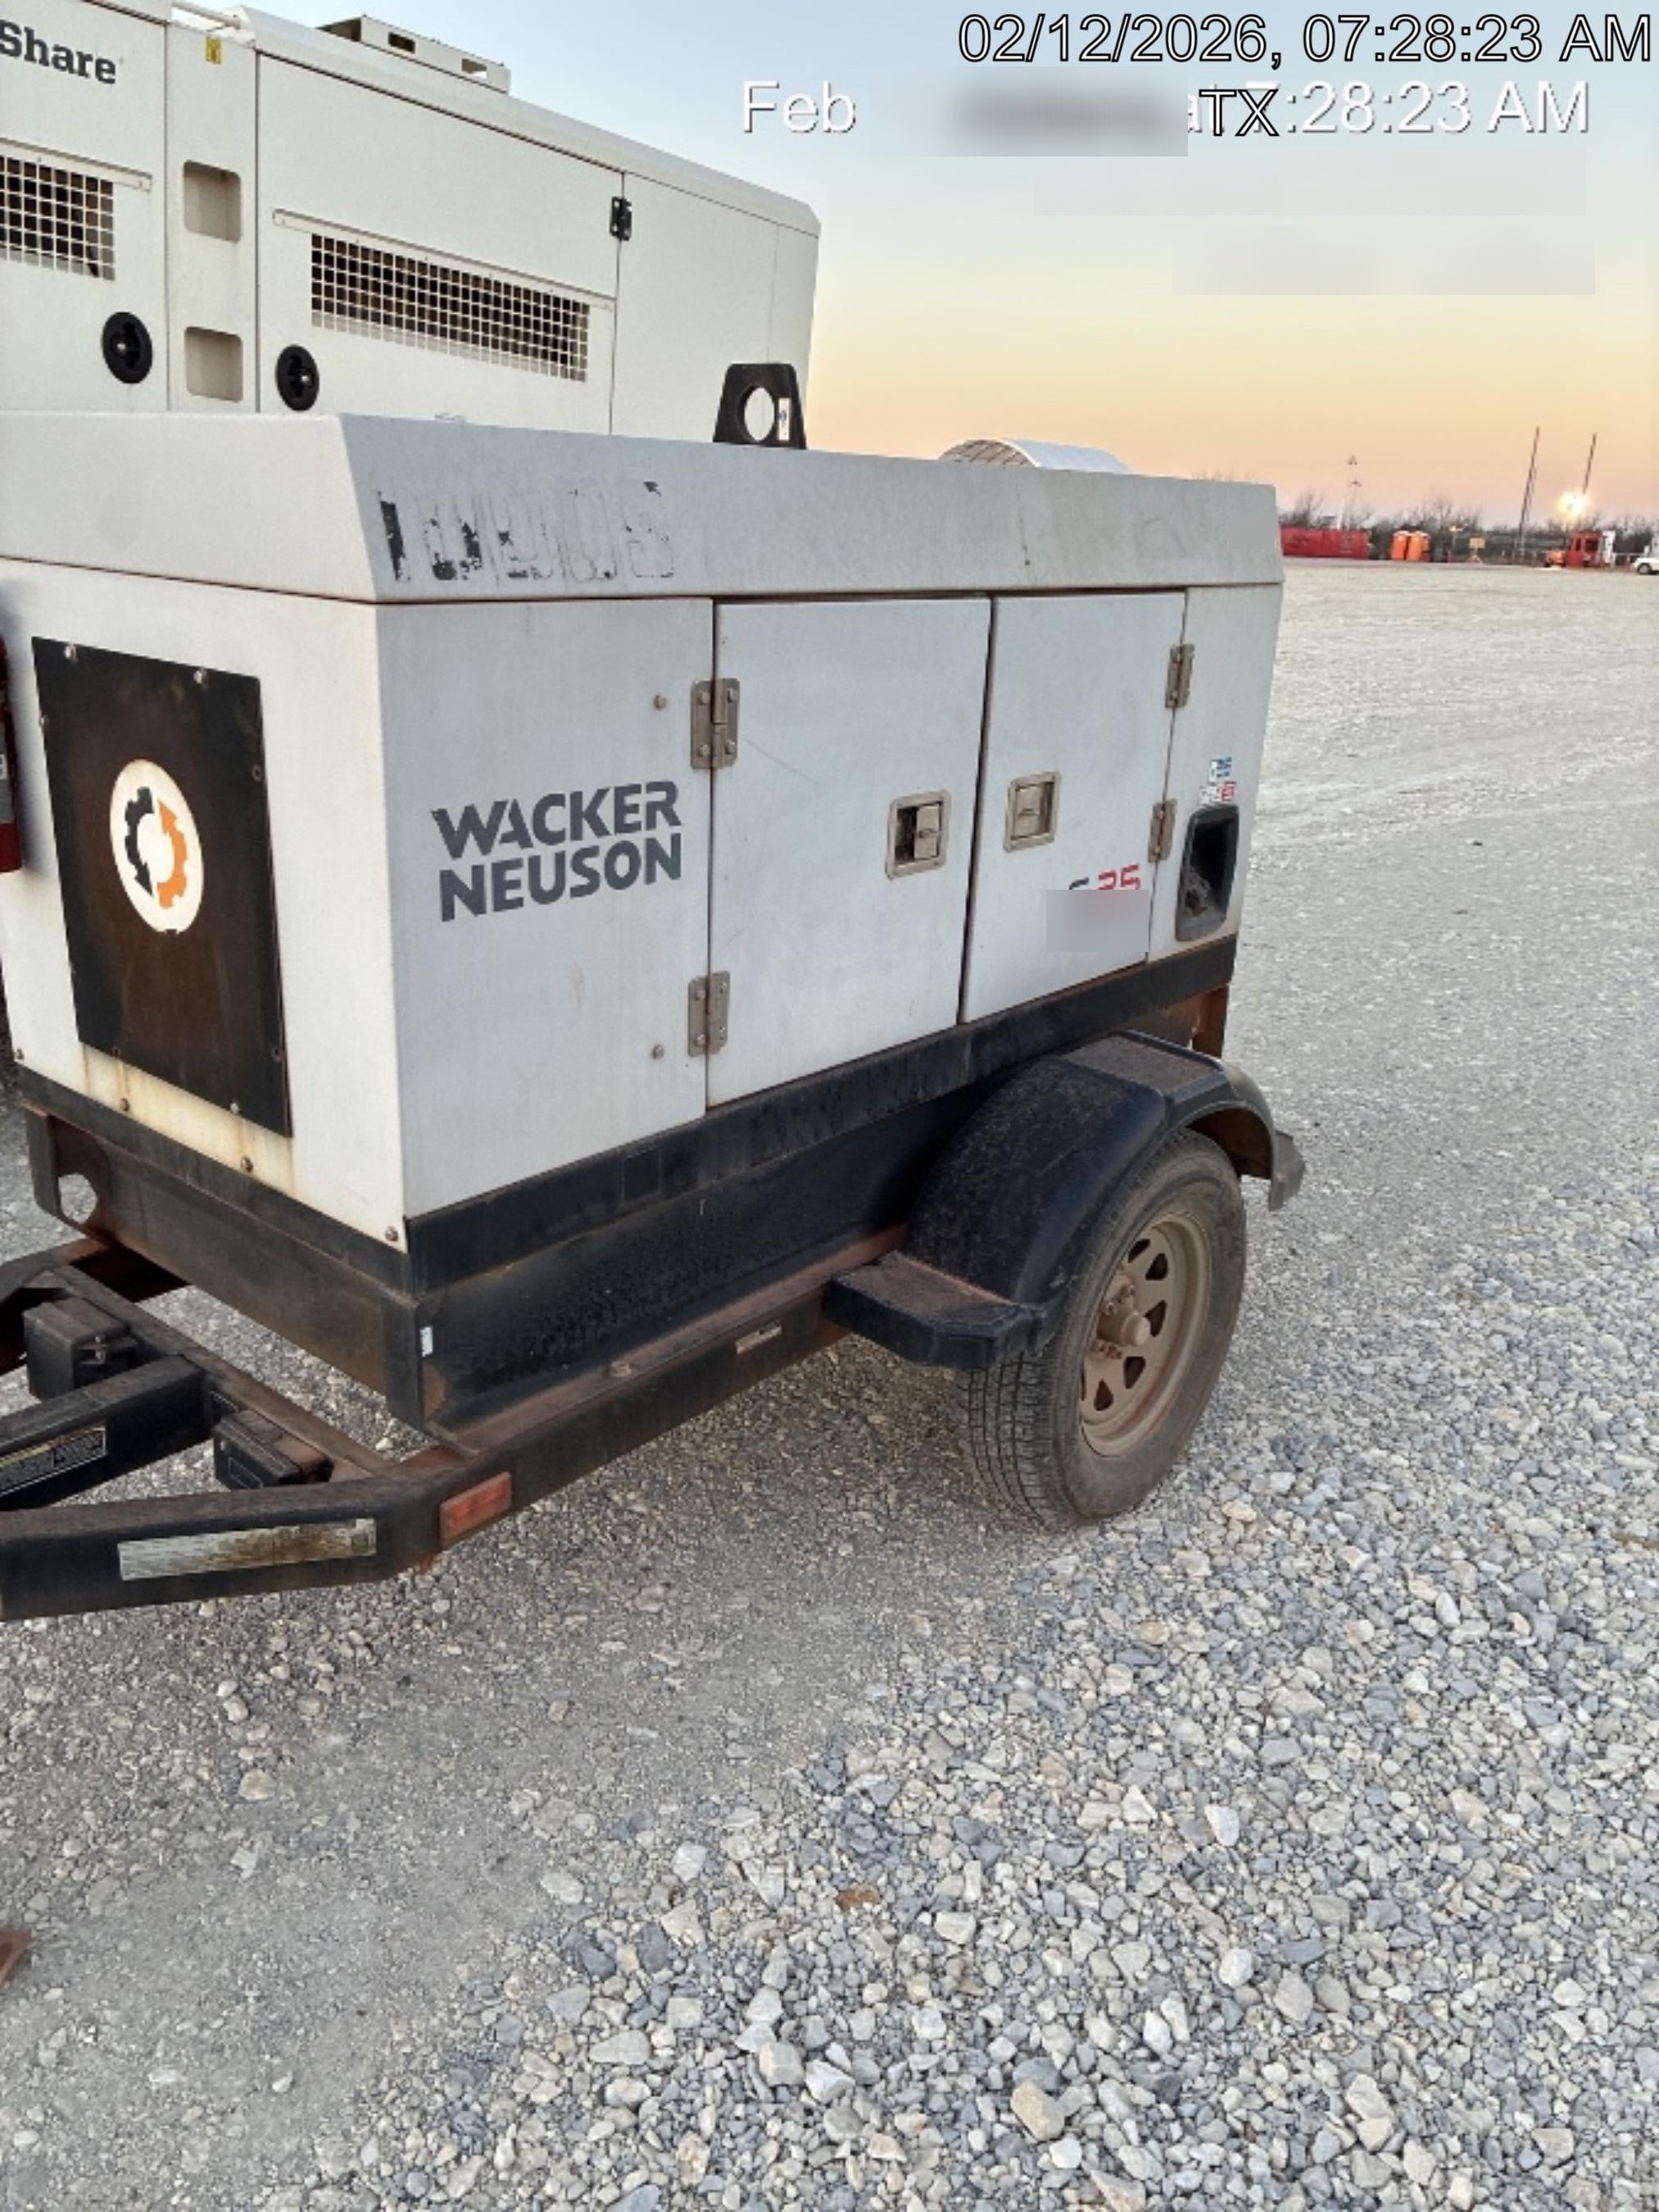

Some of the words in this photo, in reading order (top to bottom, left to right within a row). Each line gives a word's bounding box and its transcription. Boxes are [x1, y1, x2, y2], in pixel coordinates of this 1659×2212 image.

[0, 19, 116, 85] Share
[430, 780, 682, 860] WACKER
[439, 832, 682, 922] NEUSON
